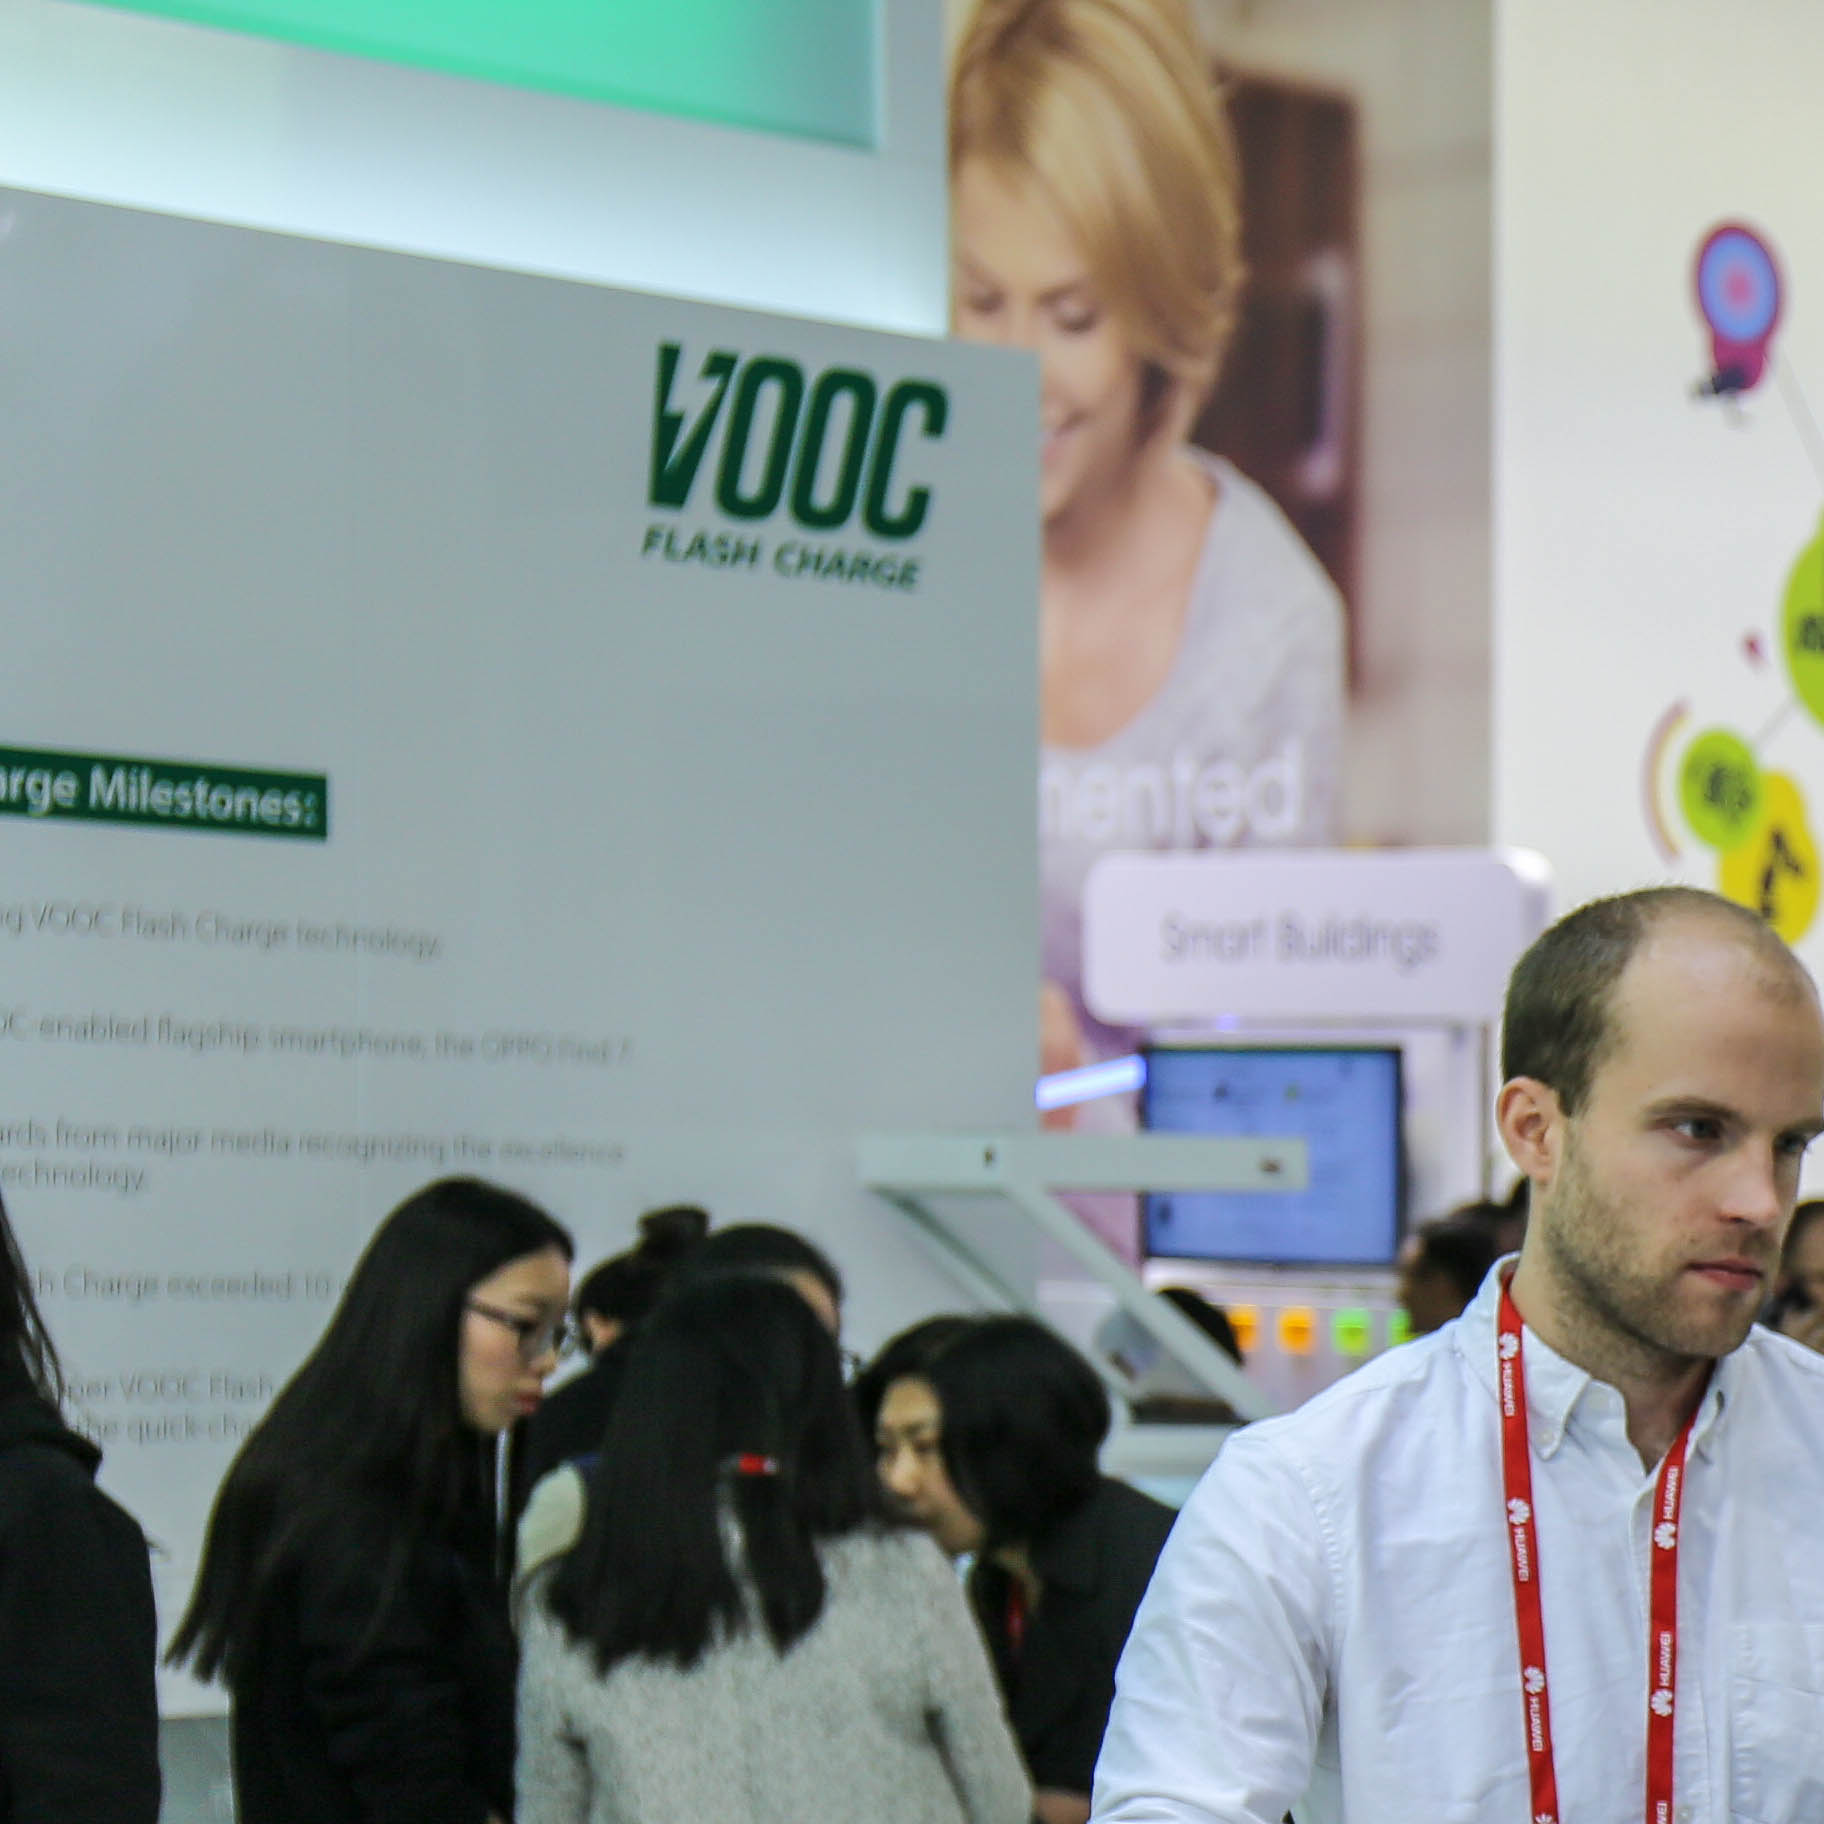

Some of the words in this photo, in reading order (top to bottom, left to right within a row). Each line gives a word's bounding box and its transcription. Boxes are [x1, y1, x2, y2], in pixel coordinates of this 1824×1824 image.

[649, 341, 949, 540] VOOC
[642, 524, 760, 568] FLASH
[773, 541, 921, 591] CHARGE
[89, 763, 319, 827] Milestones:
[120, 906, 187, 938] Flash
[195, 908, 288, 950] Charge
[56, 1117, 119, 1147] from
[127, 1124, 200, 1156] major
[210, 1125, 290, 1153] media
[63, 1266, 158, 1305] Charge
[1502, 1362, 1516, 1417] HUAWEI
[1663, 1465, 1680, 1520] HUAWEI
[1514, 1526, 1529, 1582] HUAWEI
[1660, 1631, 1673, 1687] HUAWEI
[1530, 1698, 1544, 1752] HUAWEI
